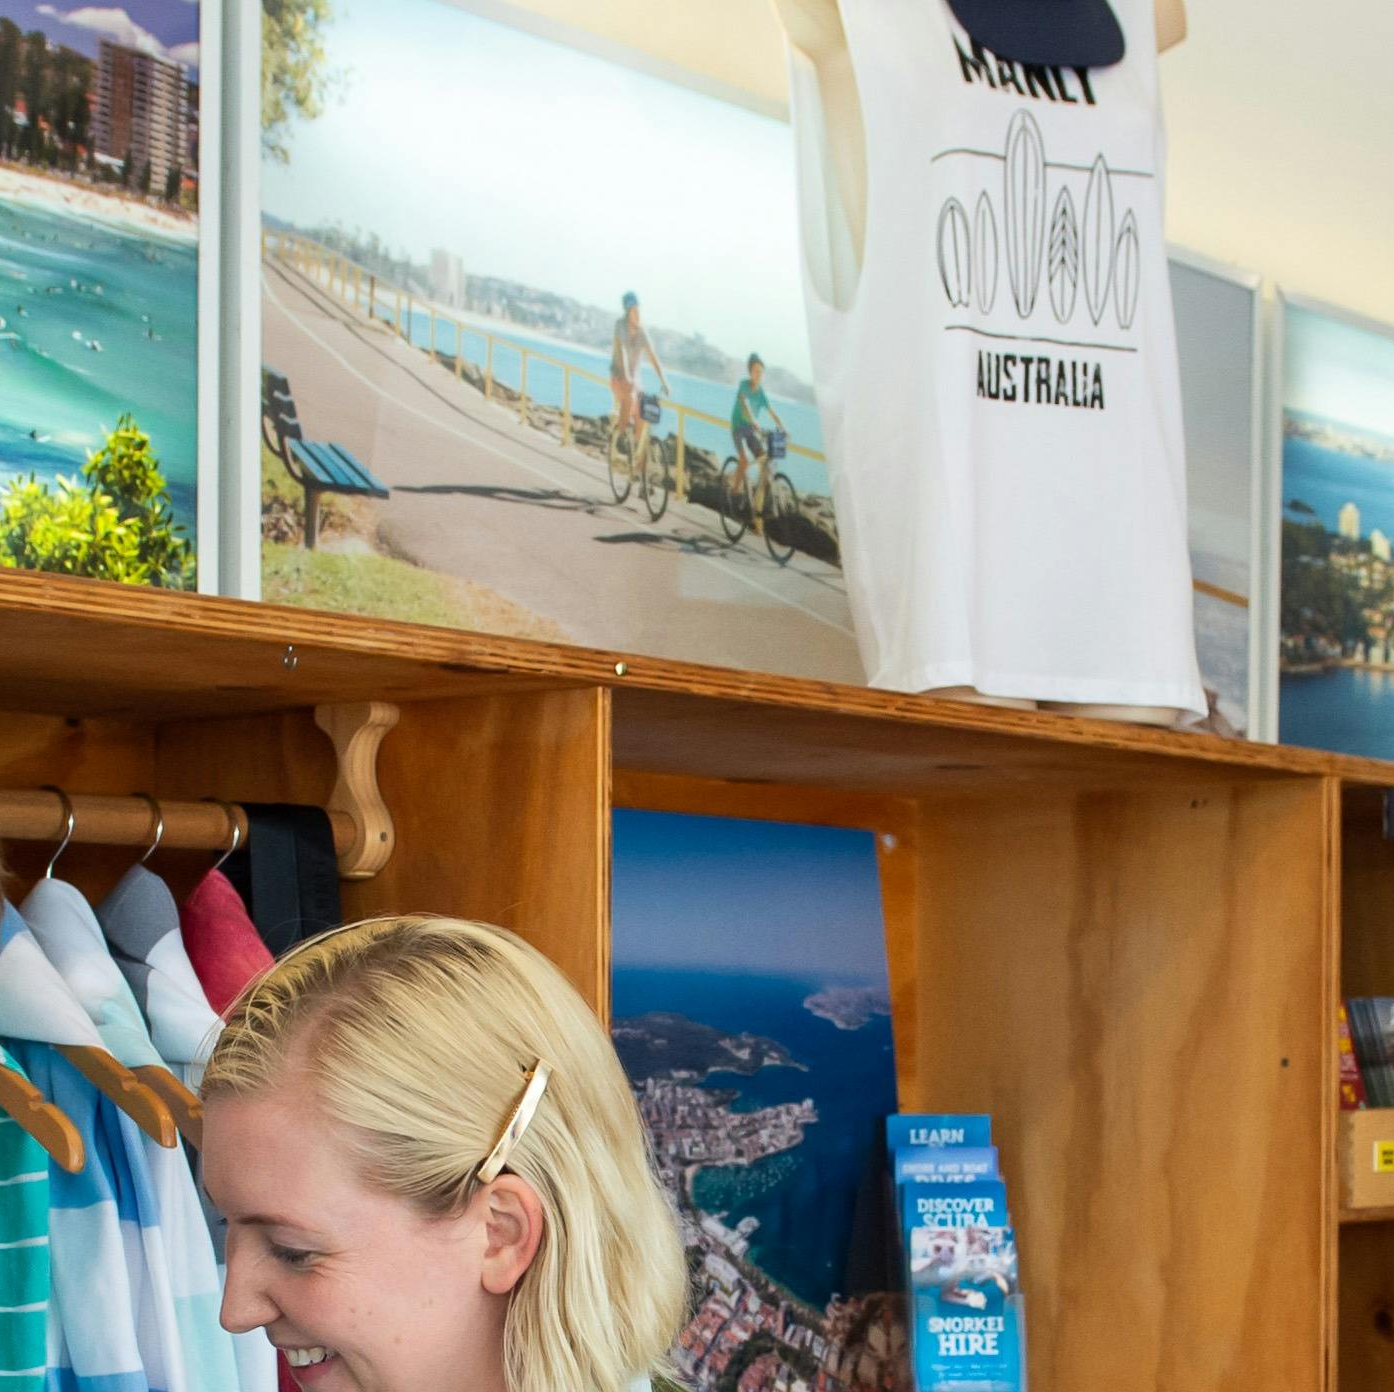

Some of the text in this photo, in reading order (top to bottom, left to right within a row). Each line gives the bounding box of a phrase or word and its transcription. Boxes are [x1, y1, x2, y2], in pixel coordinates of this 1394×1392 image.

[975, 350, 1105, 411] AUSTRALIA
[909, 1128, 965, 1145] LEARN
[917, 1197, 995, 1213] DISCOVER
[937, 1333, 999, 1356] HIRE
